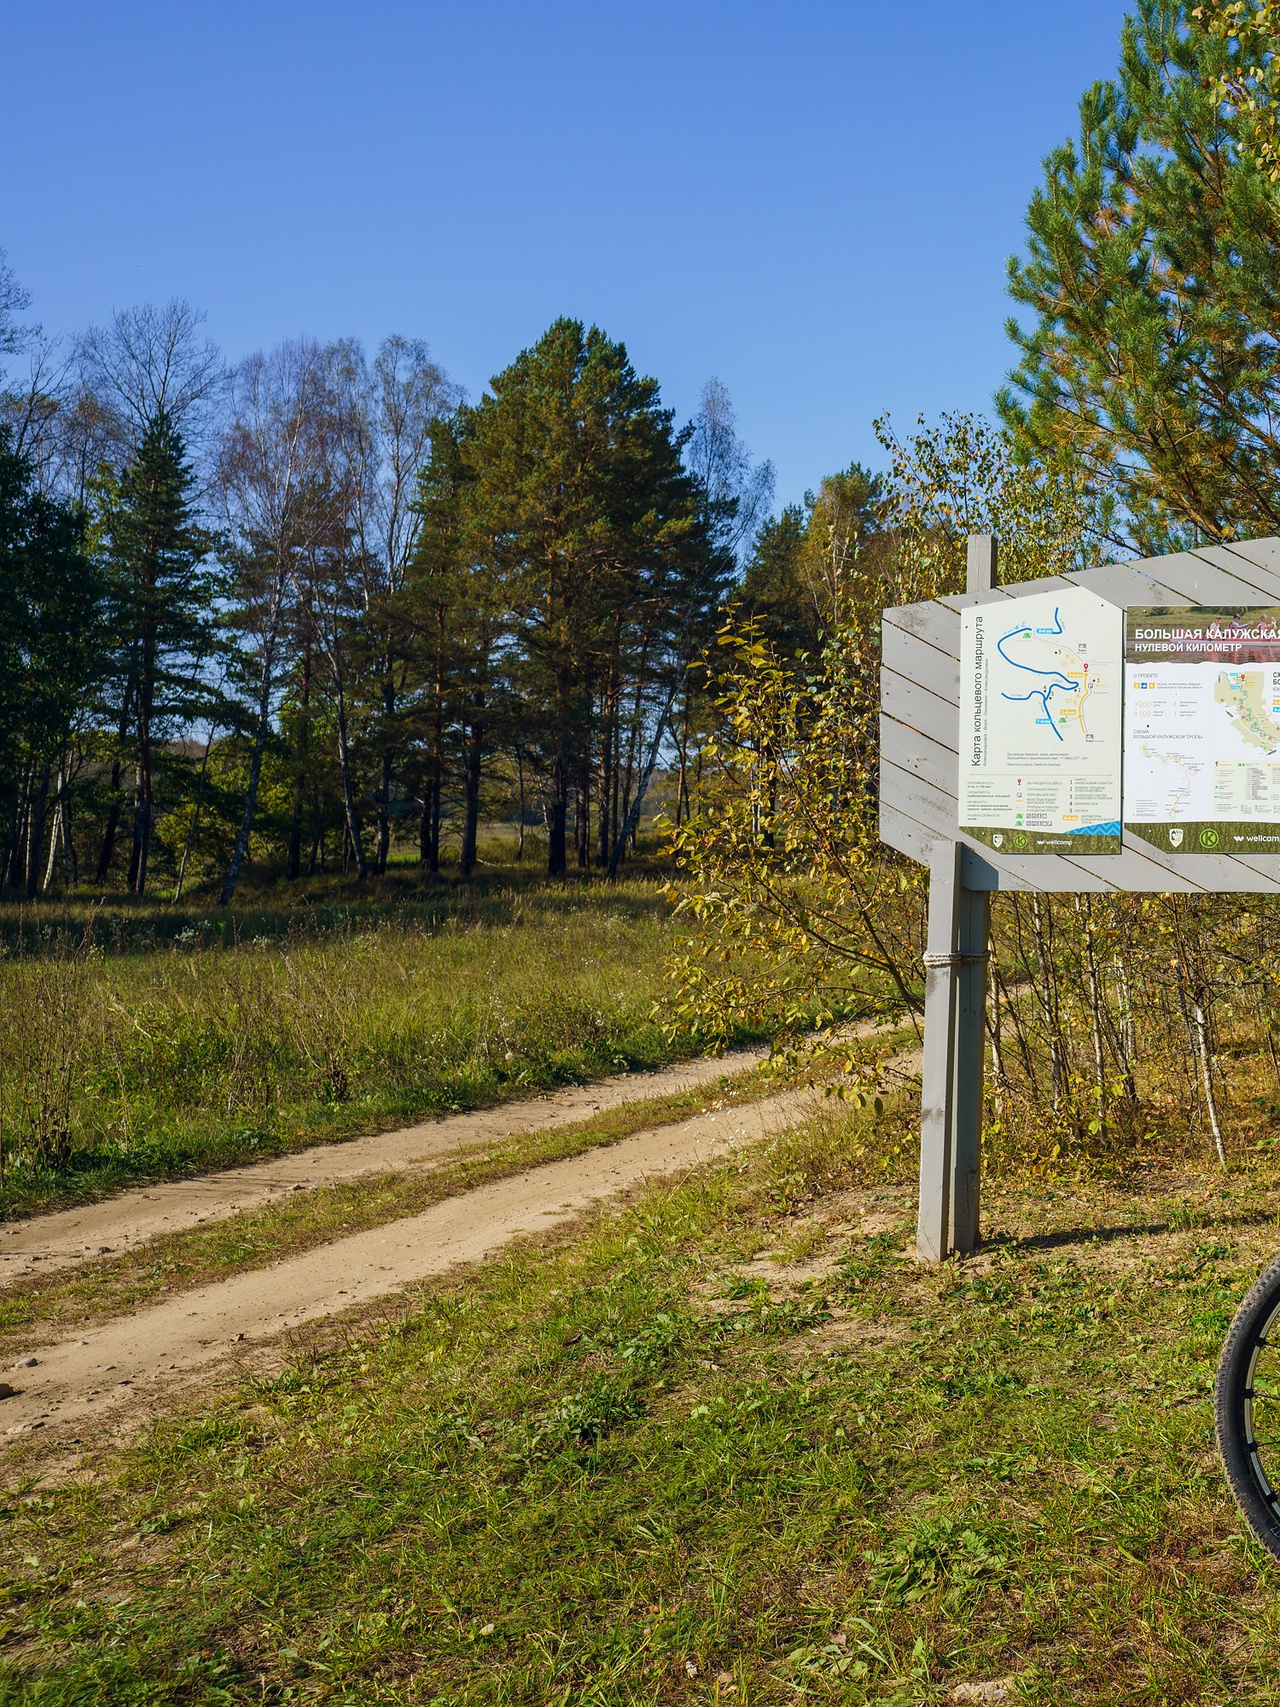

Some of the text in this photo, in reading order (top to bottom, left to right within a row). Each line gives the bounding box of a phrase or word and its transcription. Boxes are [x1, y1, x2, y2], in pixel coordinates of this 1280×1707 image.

[1134, 628, 1202, 640] БОЛЬШАЯ
[1134, 642, 1242, 652] НУЛЕВОЙ КИЛОМЕТР
[972, 616, 984, 766] Карта кольцевого маршрута
